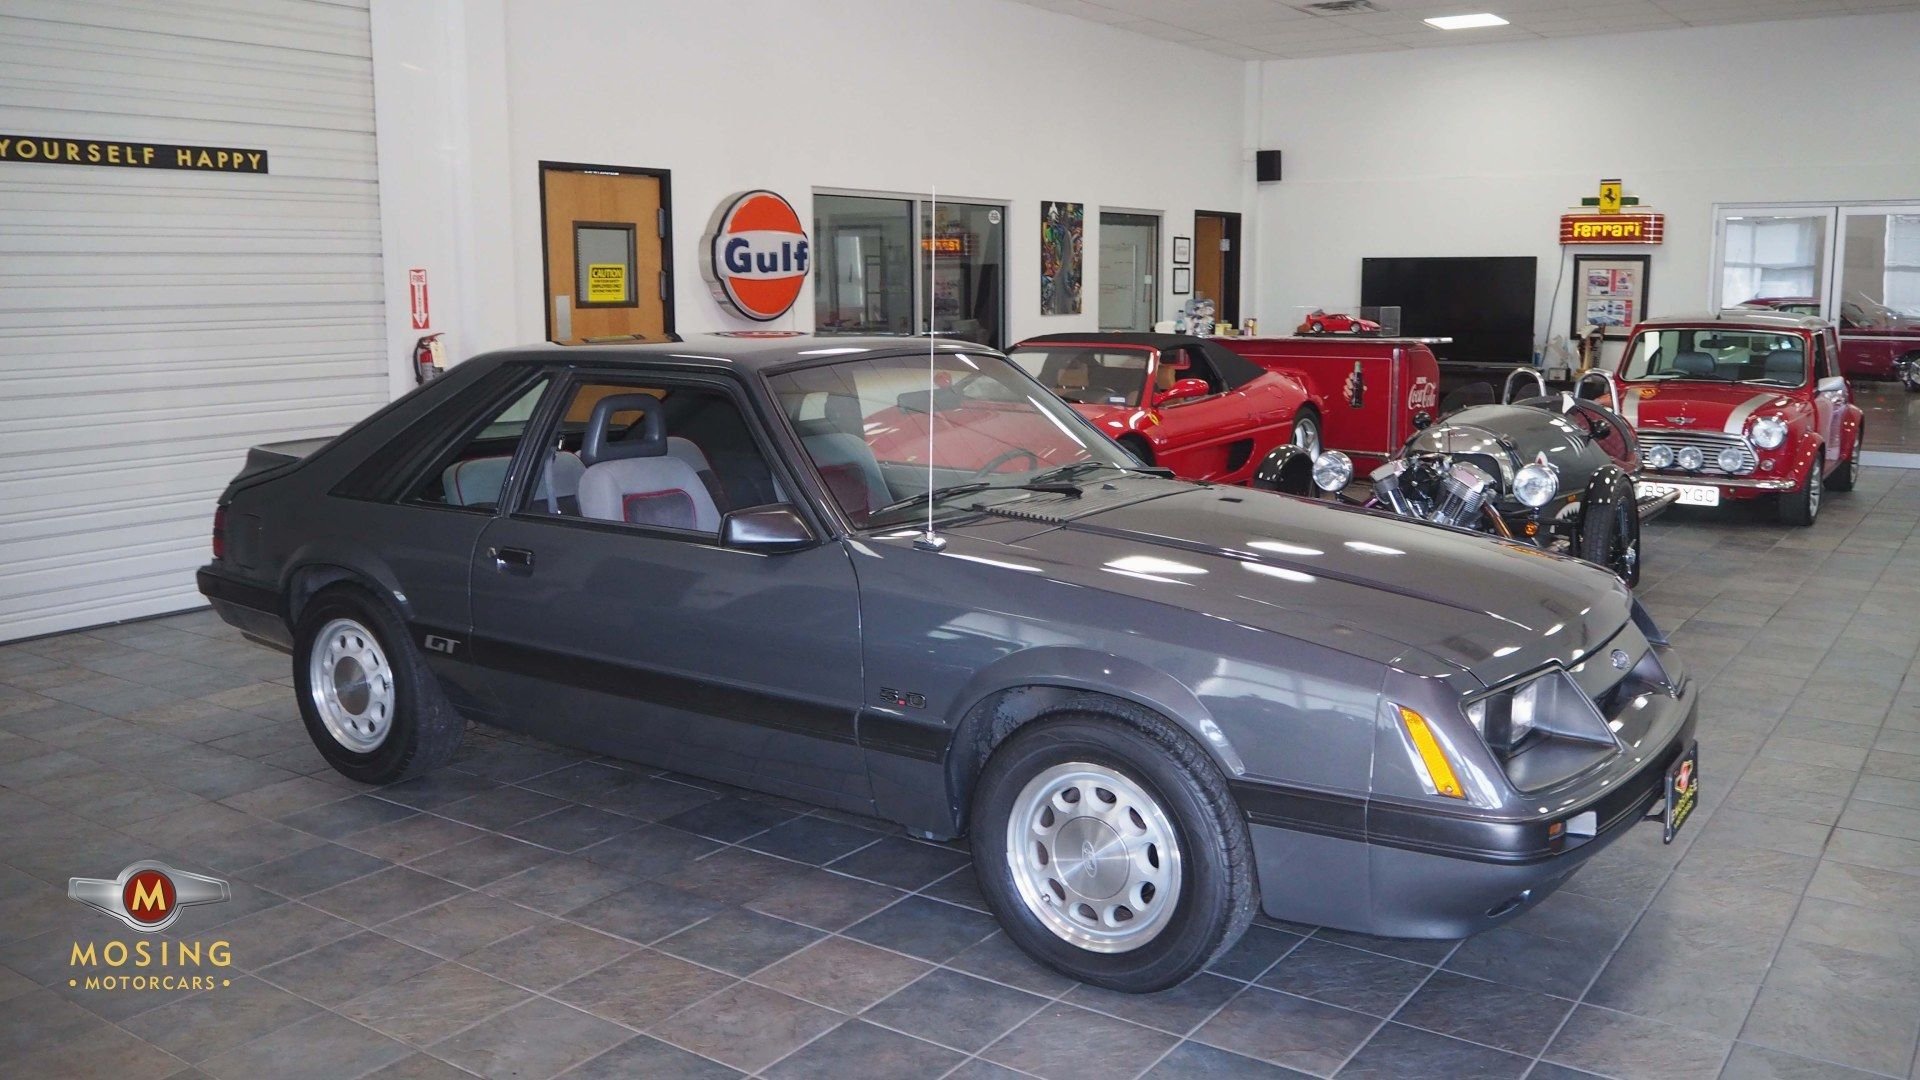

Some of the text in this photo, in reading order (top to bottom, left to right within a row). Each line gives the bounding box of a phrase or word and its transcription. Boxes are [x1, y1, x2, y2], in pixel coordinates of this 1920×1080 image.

[0, 139, 261, 170] YOURSELF HAPPY
[1573, 221, 1642, 238] Ferrari
[724, 237, 808, 273] Gulf
[592, 268, 622, 278] CAUTION
[425, 635, 461, 654] GT
